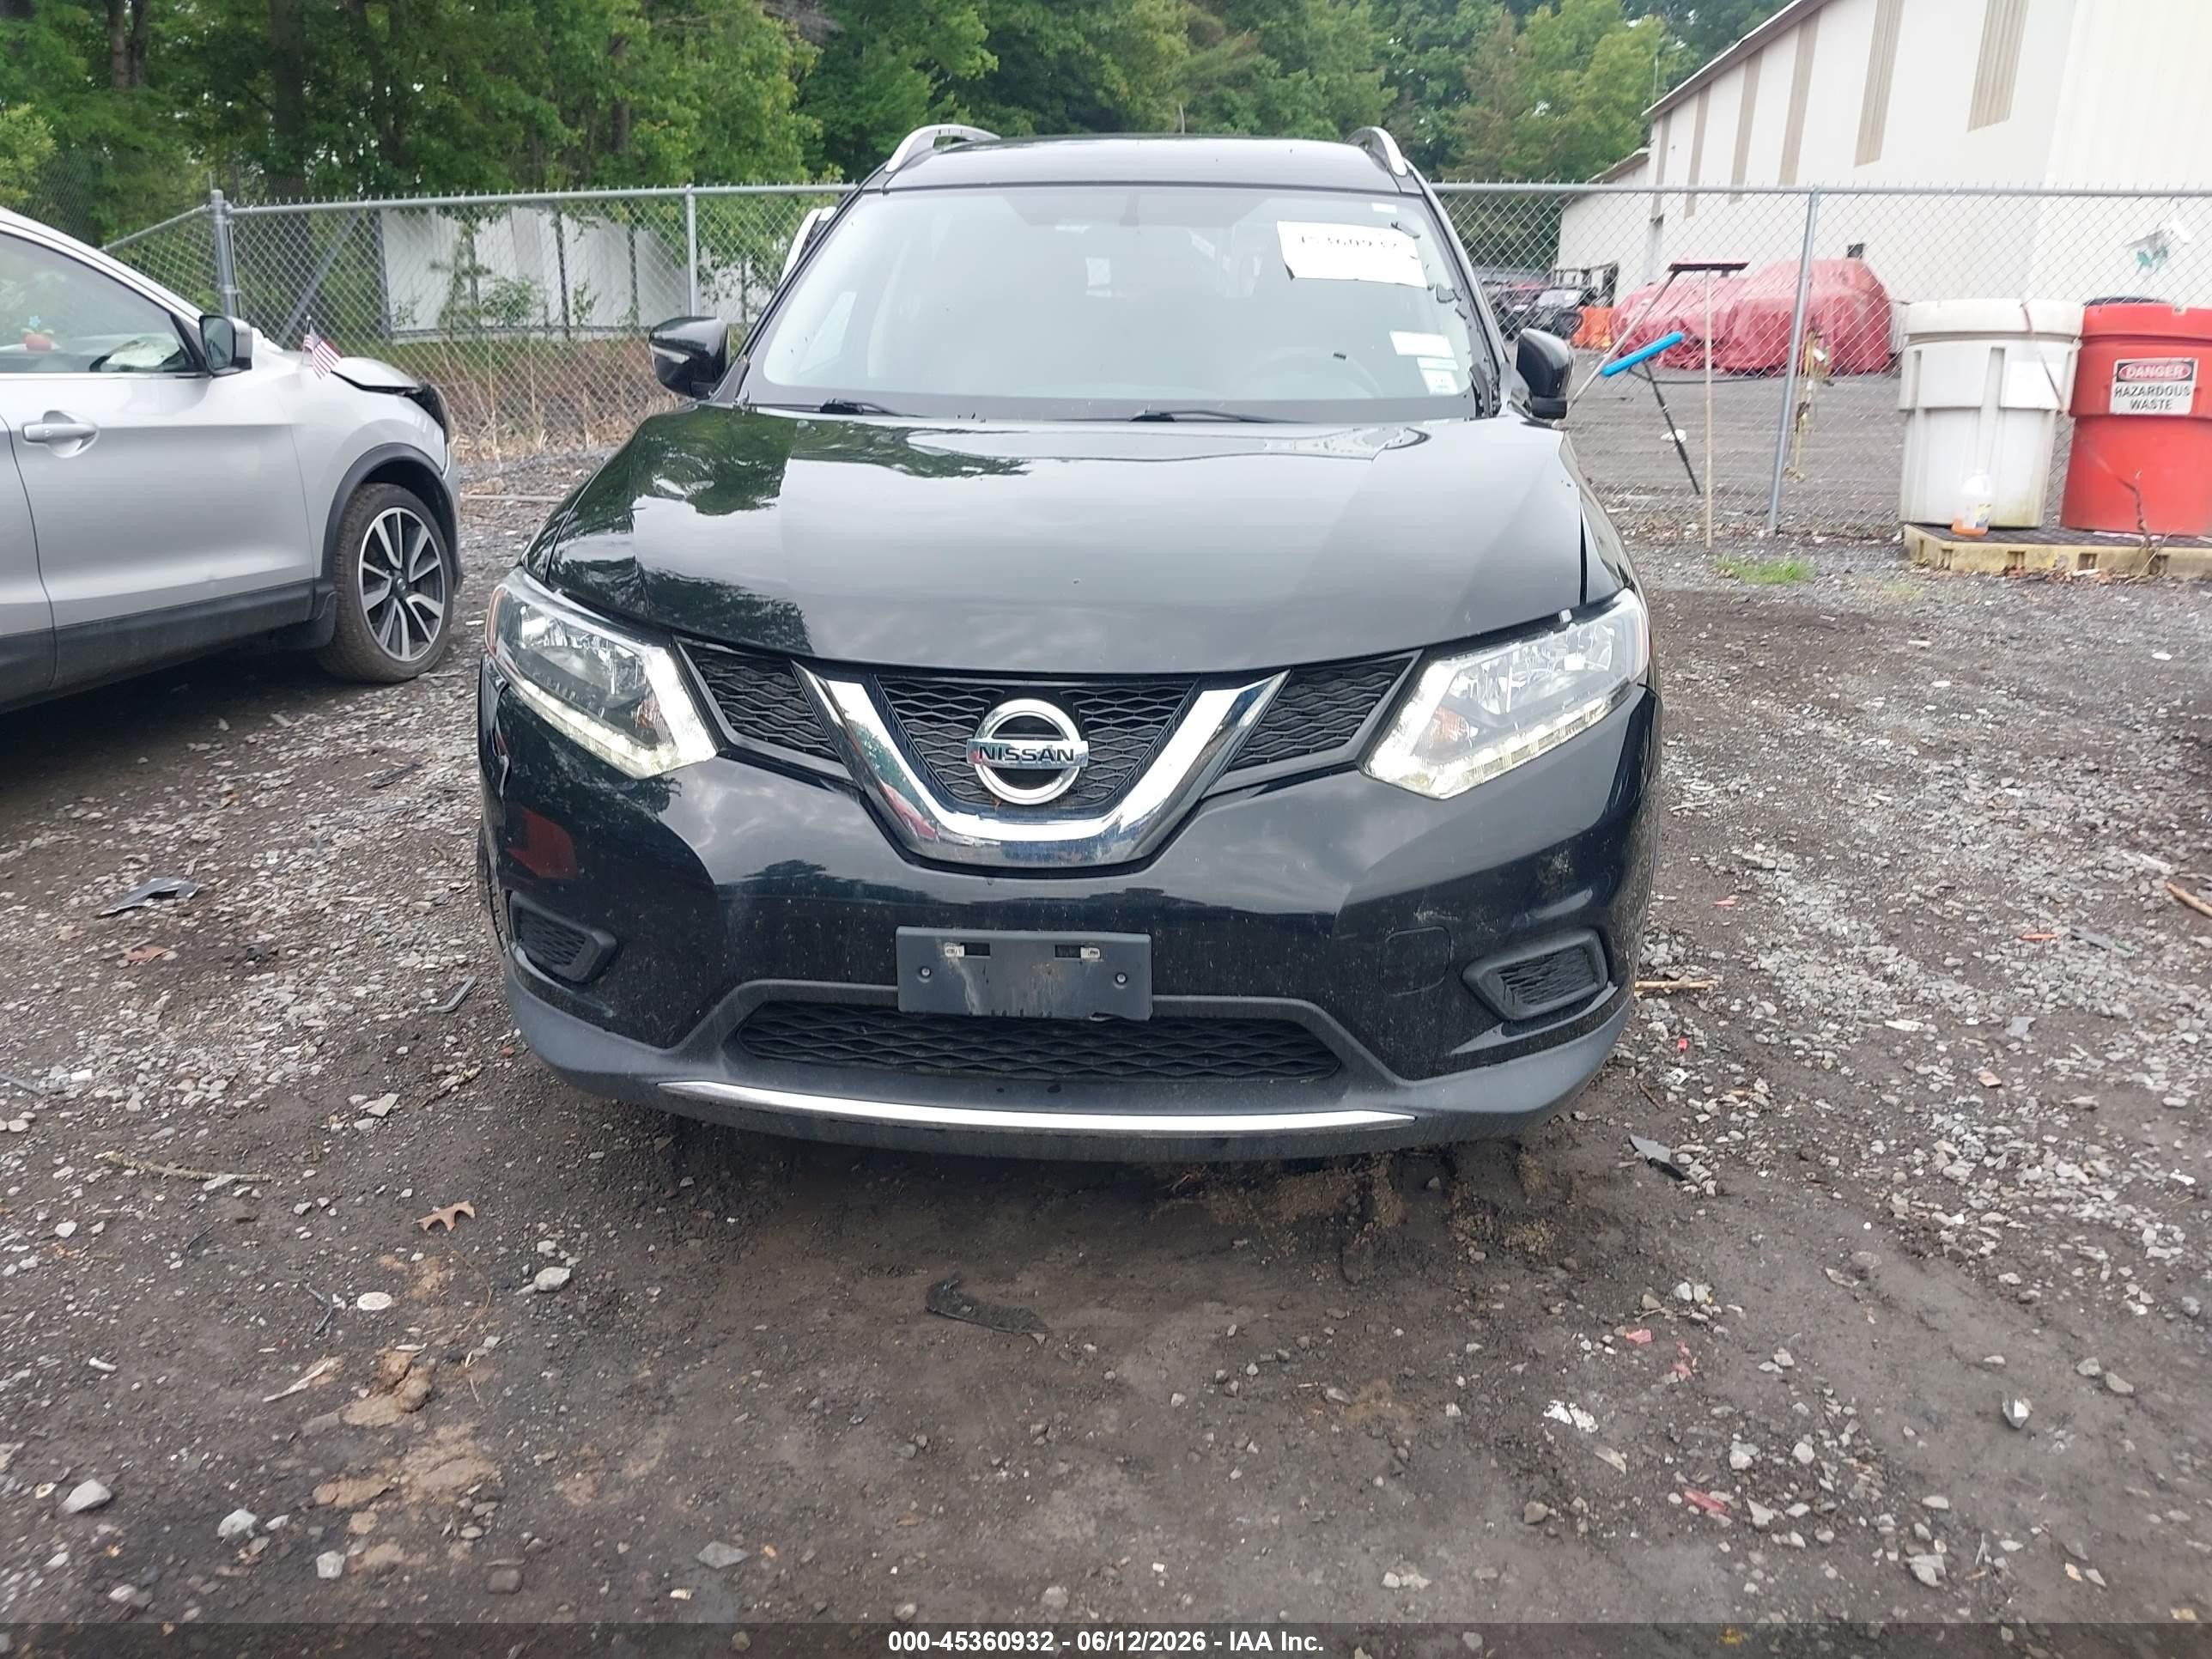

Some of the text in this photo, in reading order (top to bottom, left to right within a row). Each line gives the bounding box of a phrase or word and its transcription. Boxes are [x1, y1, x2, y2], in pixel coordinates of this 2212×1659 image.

[2126, 363, 2185, 379] DANGER
[2114, 384, 2191, 398] HAZARDOUS
[2130, 398, 2173, 410] WASTE
[979, 746, 1074, 763] NISSAN
